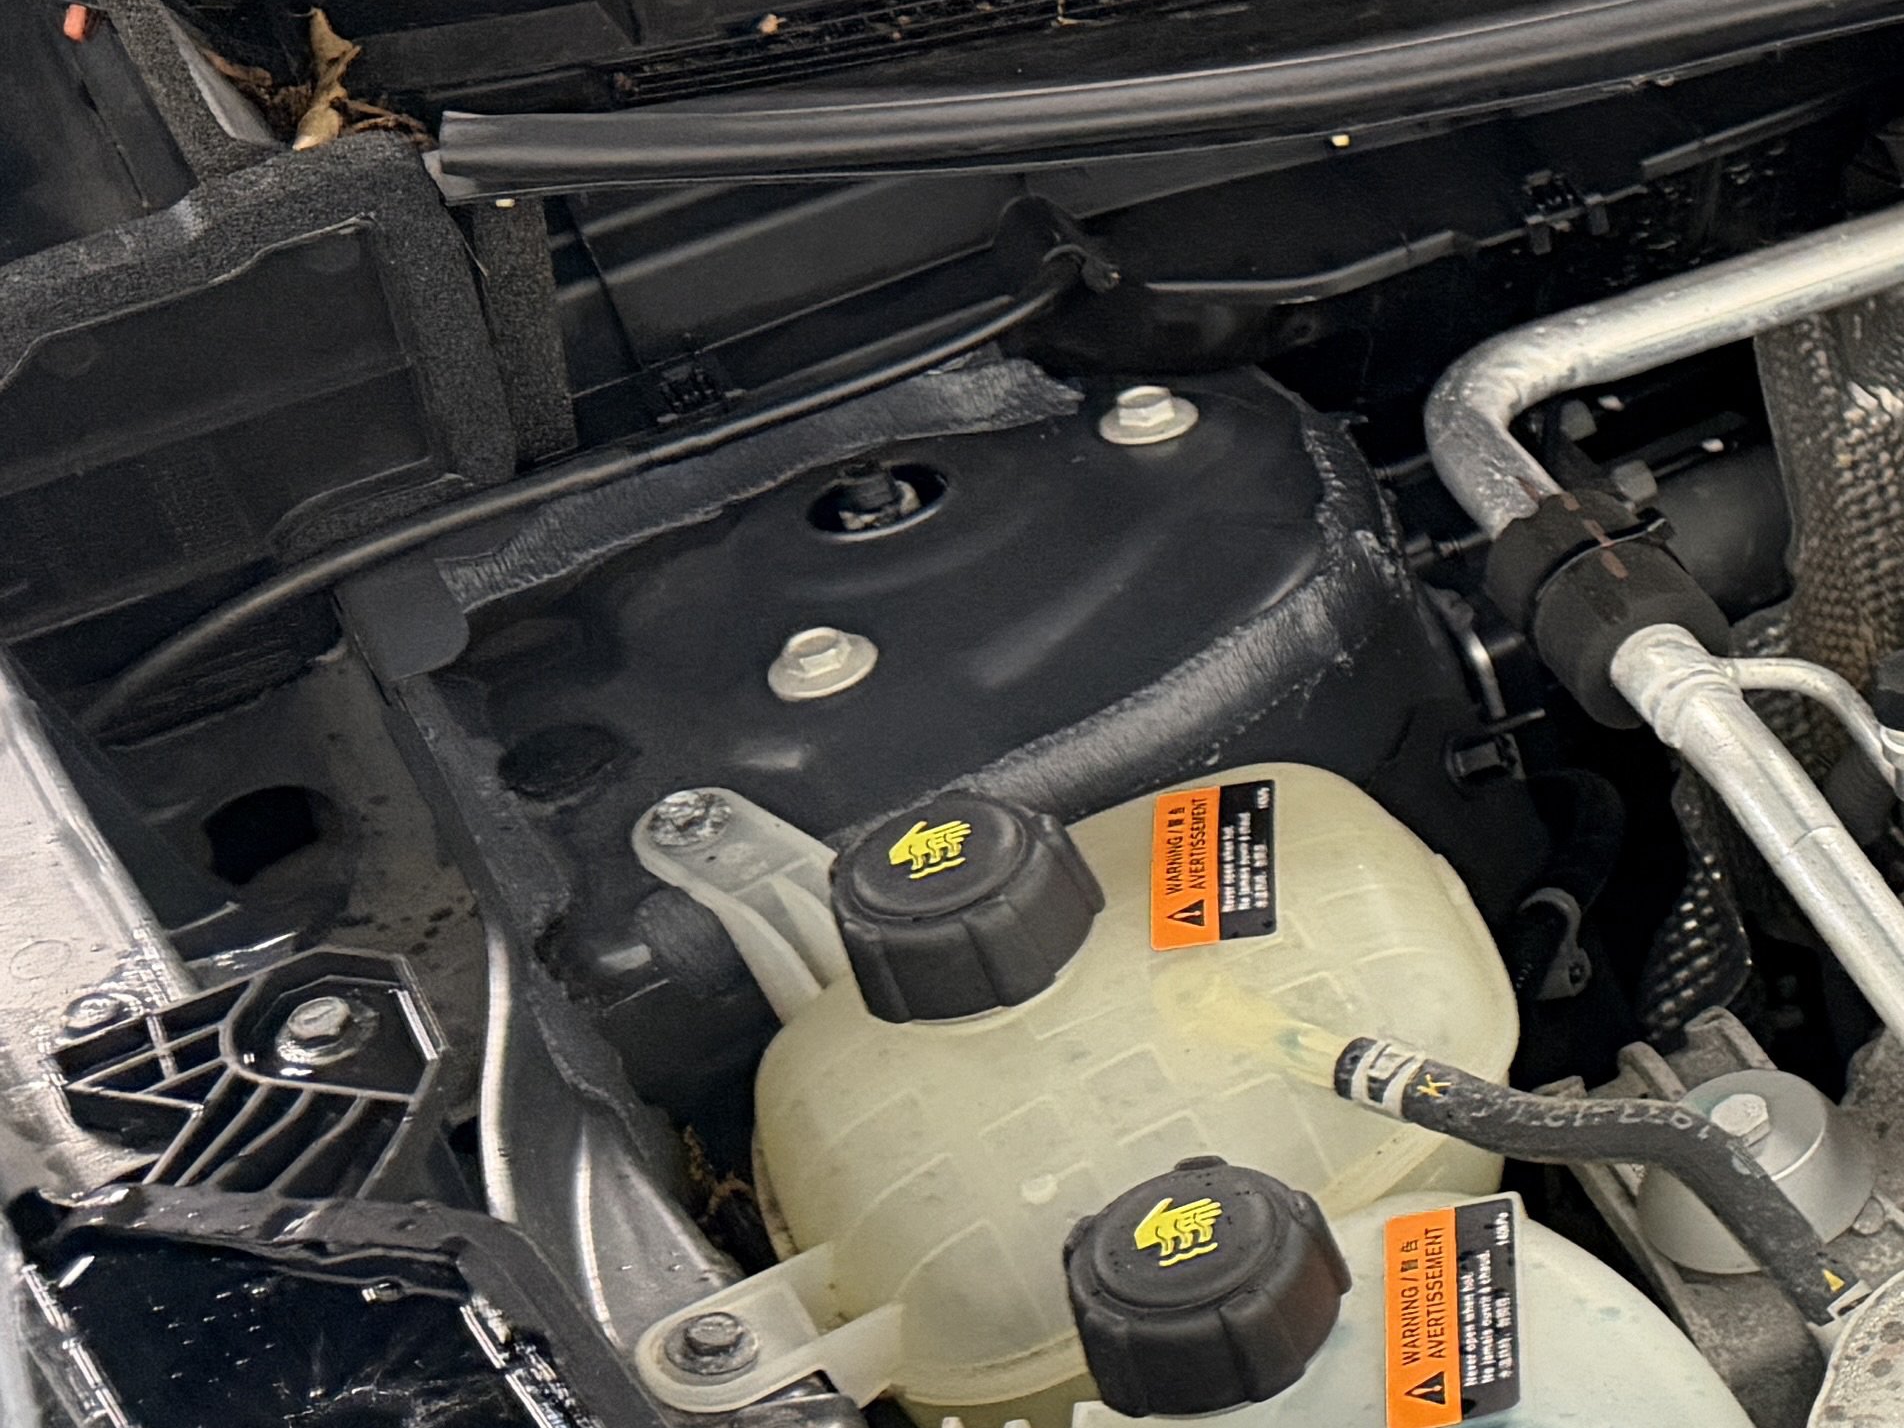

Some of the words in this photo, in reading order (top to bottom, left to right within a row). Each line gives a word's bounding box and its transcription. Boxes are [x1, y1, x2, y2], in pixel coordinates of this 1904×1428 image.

[1165, 836, 1183, 894] WARNING
[1189, 798, 1206, 890] AVERTISSEMENT
[1401, 1285, 1421, 1366] WARNING
[1424, 1226, 1446, 1361] AVERTISSEMENT
